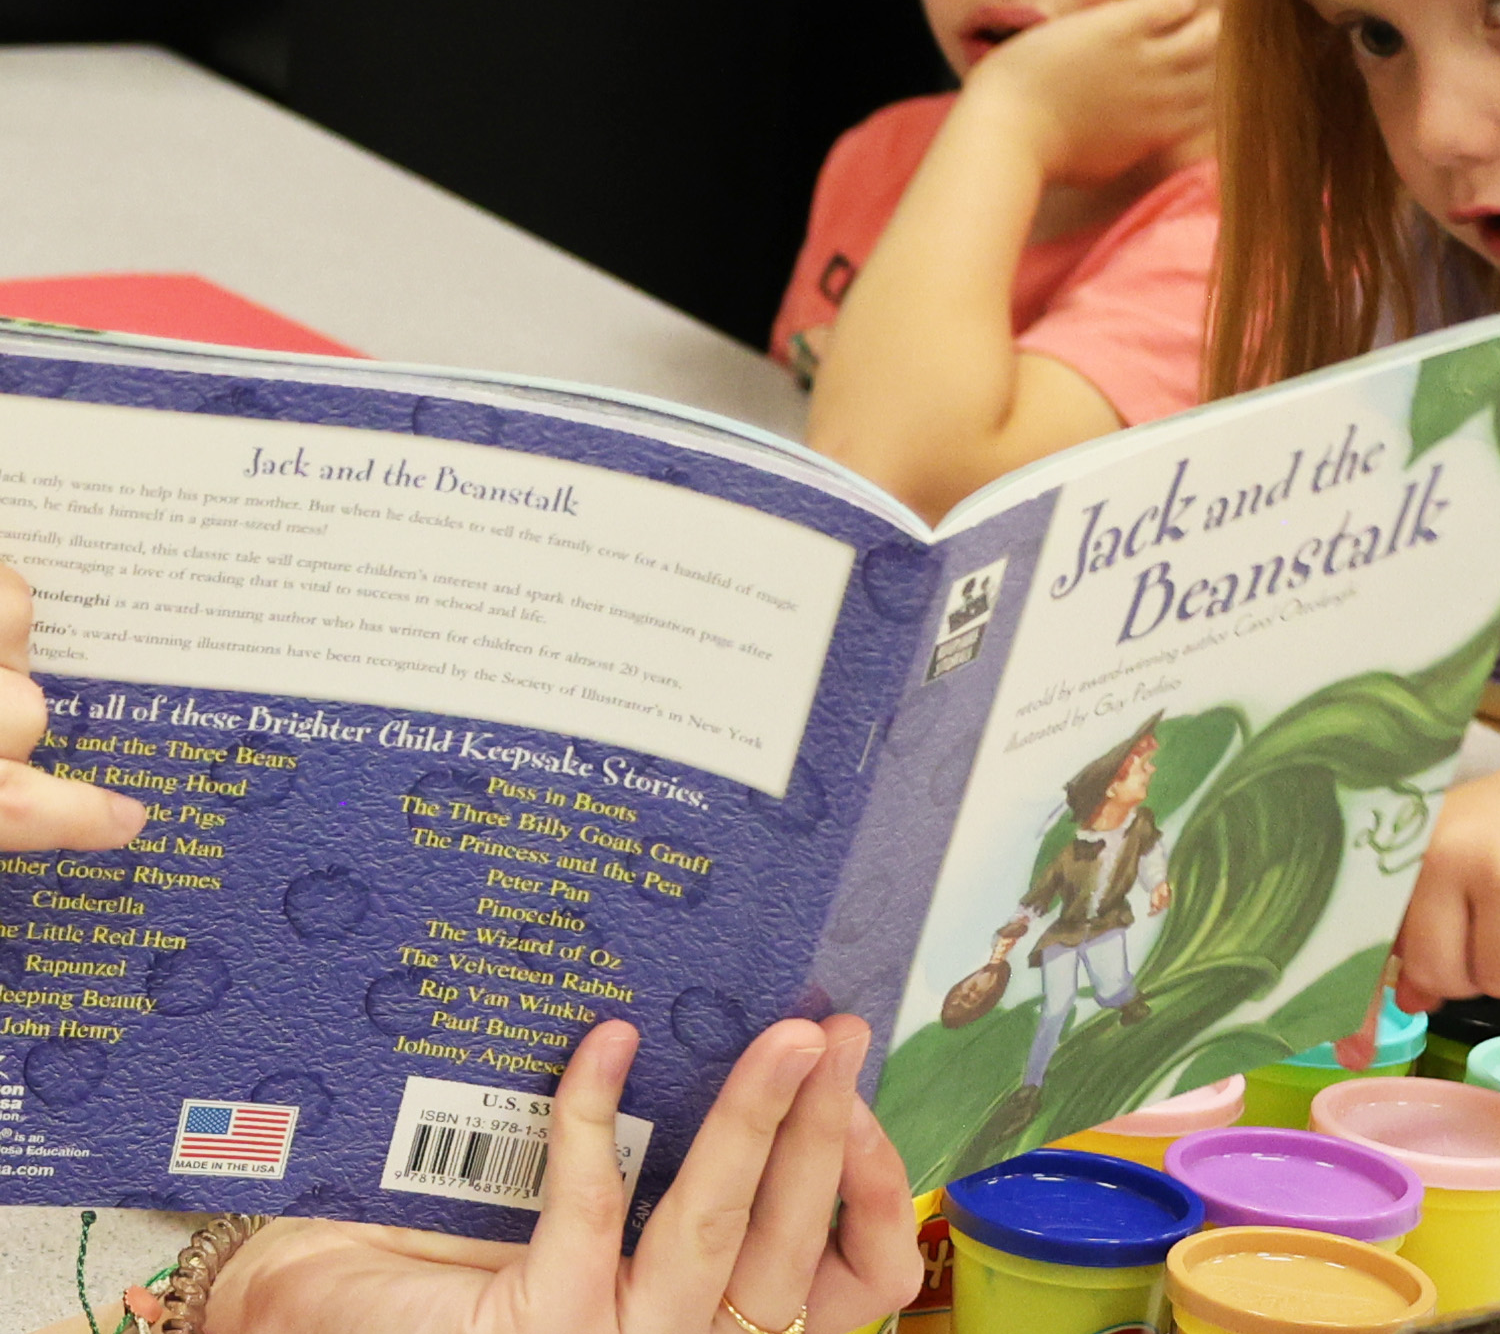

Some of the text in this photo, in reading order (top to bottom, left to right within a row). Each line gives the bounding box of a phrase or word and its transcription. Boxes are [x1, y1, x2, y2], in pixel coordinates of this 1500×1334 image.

[244, 447, 578, 516] Jack and the Beanstalk
[44, 498, 60, 509] he
[68, 503, 102, 514] finds
[111, 505, 163, 520] himself
[201, 518, 281, 530] giant-sized
[287, 525, 328, 534] mess!
[1050, 423, 1385, 600] Jack and the
[1115, 464, 1451, 645] Beanstalk
[70, 535, 145, 555] illustrated,
[153, 544, 177, 555] this
[184, 547, 228, 560] classic
[236, 552, 260, 563] tale
[267, 555, 292, 565] will
[297, 560, 351, 572] capture
[357, 563, 427, 580] children's
[433, 576, 487, 590] interest
[494, 585, 520, 595] and
[527, 591, 563, 603] spark
[571, 597, 604, 612] their
[610, 607, 695, 636] imagination
[700, 631, 731, 647] page
[740, 645, 772, 659] after
[132, 602, 149, 610] an
[155, 603, 263, 622] award-winning
[269, 612, 316, 625] author
[323, 616, 354, 628] who
[359, 619, 382, 631] has
[390, 627, 440, 639] written
[447, 632, 468, 643] for
[473, 635, 532, 654] children
[539, 646, 560, 659] for
[566, 653, 614, 671] almost
[620, 664, 638, 675] 20
[644, 672, 682, 687] years.
[76, 736, 118, 752] and
[123, 738, 158, 756] the
[167, 740, 229, 763] Three
[236, 746, 297, 769] Bears
[90, 694, 125, 720] all
[133, 695, 165, 721] of
[171, 698, 242, 728] these
[248, 706, 371, 742] Brighter
[379, 720, 453, 754] Child
[459, 732, 593, 778] Keepsake
[604, 757, 708, 810] Stories.
[53, 762, 98, 783] Red
[104, 766, 179, 795] Riding
[186, 774, 248, 797] Hood
[487, 777, 637, 821] Puss in Boots
[179, 805, 226, 830] Pigs
[401, 795, 712, 874] The Three Billy Goats Gruff
[173, 838, 224, 858] Man
[414, 827, 683, 897] The Princess and the Pea
[56, 859, 126, 881] Goose
[132, 865, 222, 890] Rhymes
[487, 869, 591, 902] Peter Pan
[32, 890, 145, 915] Cinderella
[477, 897, 586, 931] Pinocchio
[26, 922, 85, 943] Little
[92, 925, 137, 946] Red
[142, 930, 187, 950] Hen
[427, 920, 622, 969] The Wizard of Oz
[25, 954, 127, 977] Rapunzel
[400, 947, 634, 1003] The Velveteen Rabbit
[82, 989, 156, 1014] Beauty
[420, 979, 596, 1024] Rip Van Winkle
[0, 1017, 124, 1044] John Henry
[431, 1011, 569, 1047] Paul Bunyan
[394, 1036, 566, 1075] Johnny Applese
[483, 1093, 551, 1117] U.S. $3
[14, 1133, 25, 1142] is
[28, 1134, 44, 1143] an
[420, 1110, 549, 1139] ISBN 13: 978-1-5
[26, 1146, 89, 1157] Education
[175, 1160, 276, 1173] MADE IN THE USA
[393, 1170, 533, 1199] 9 781577 683773
